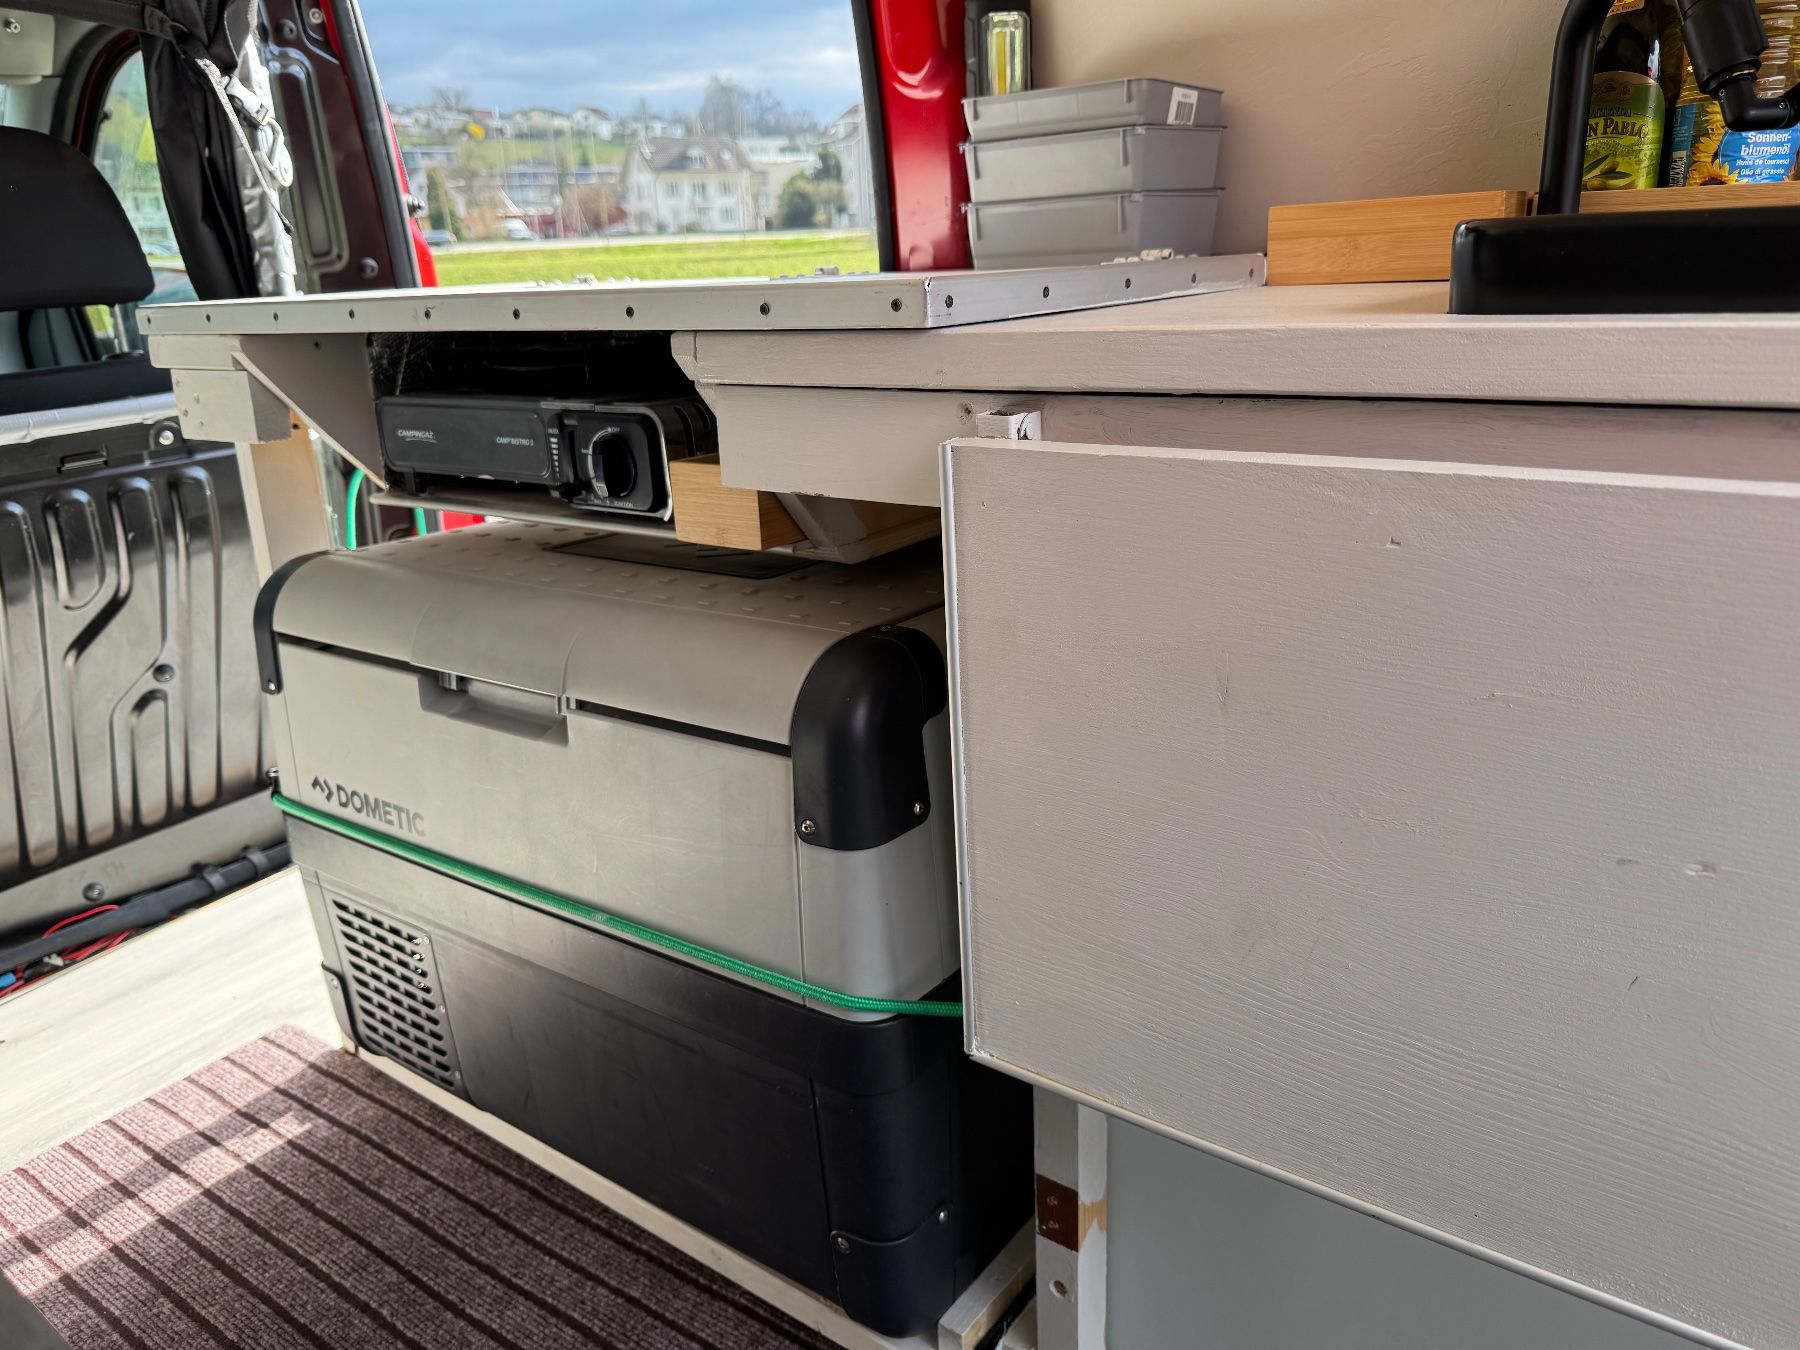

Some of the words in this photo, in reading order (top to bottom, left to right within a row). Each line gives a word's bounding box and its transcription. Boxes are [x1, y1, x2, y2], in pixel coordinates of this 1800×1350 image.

[1601, 117, 1649, 139] PABLO
[1747, 131, 1792, 143] Sonnen-
[1740, 143, 1791, 156] blumenöl
[336, 783, 426, 837] DOMETIC
